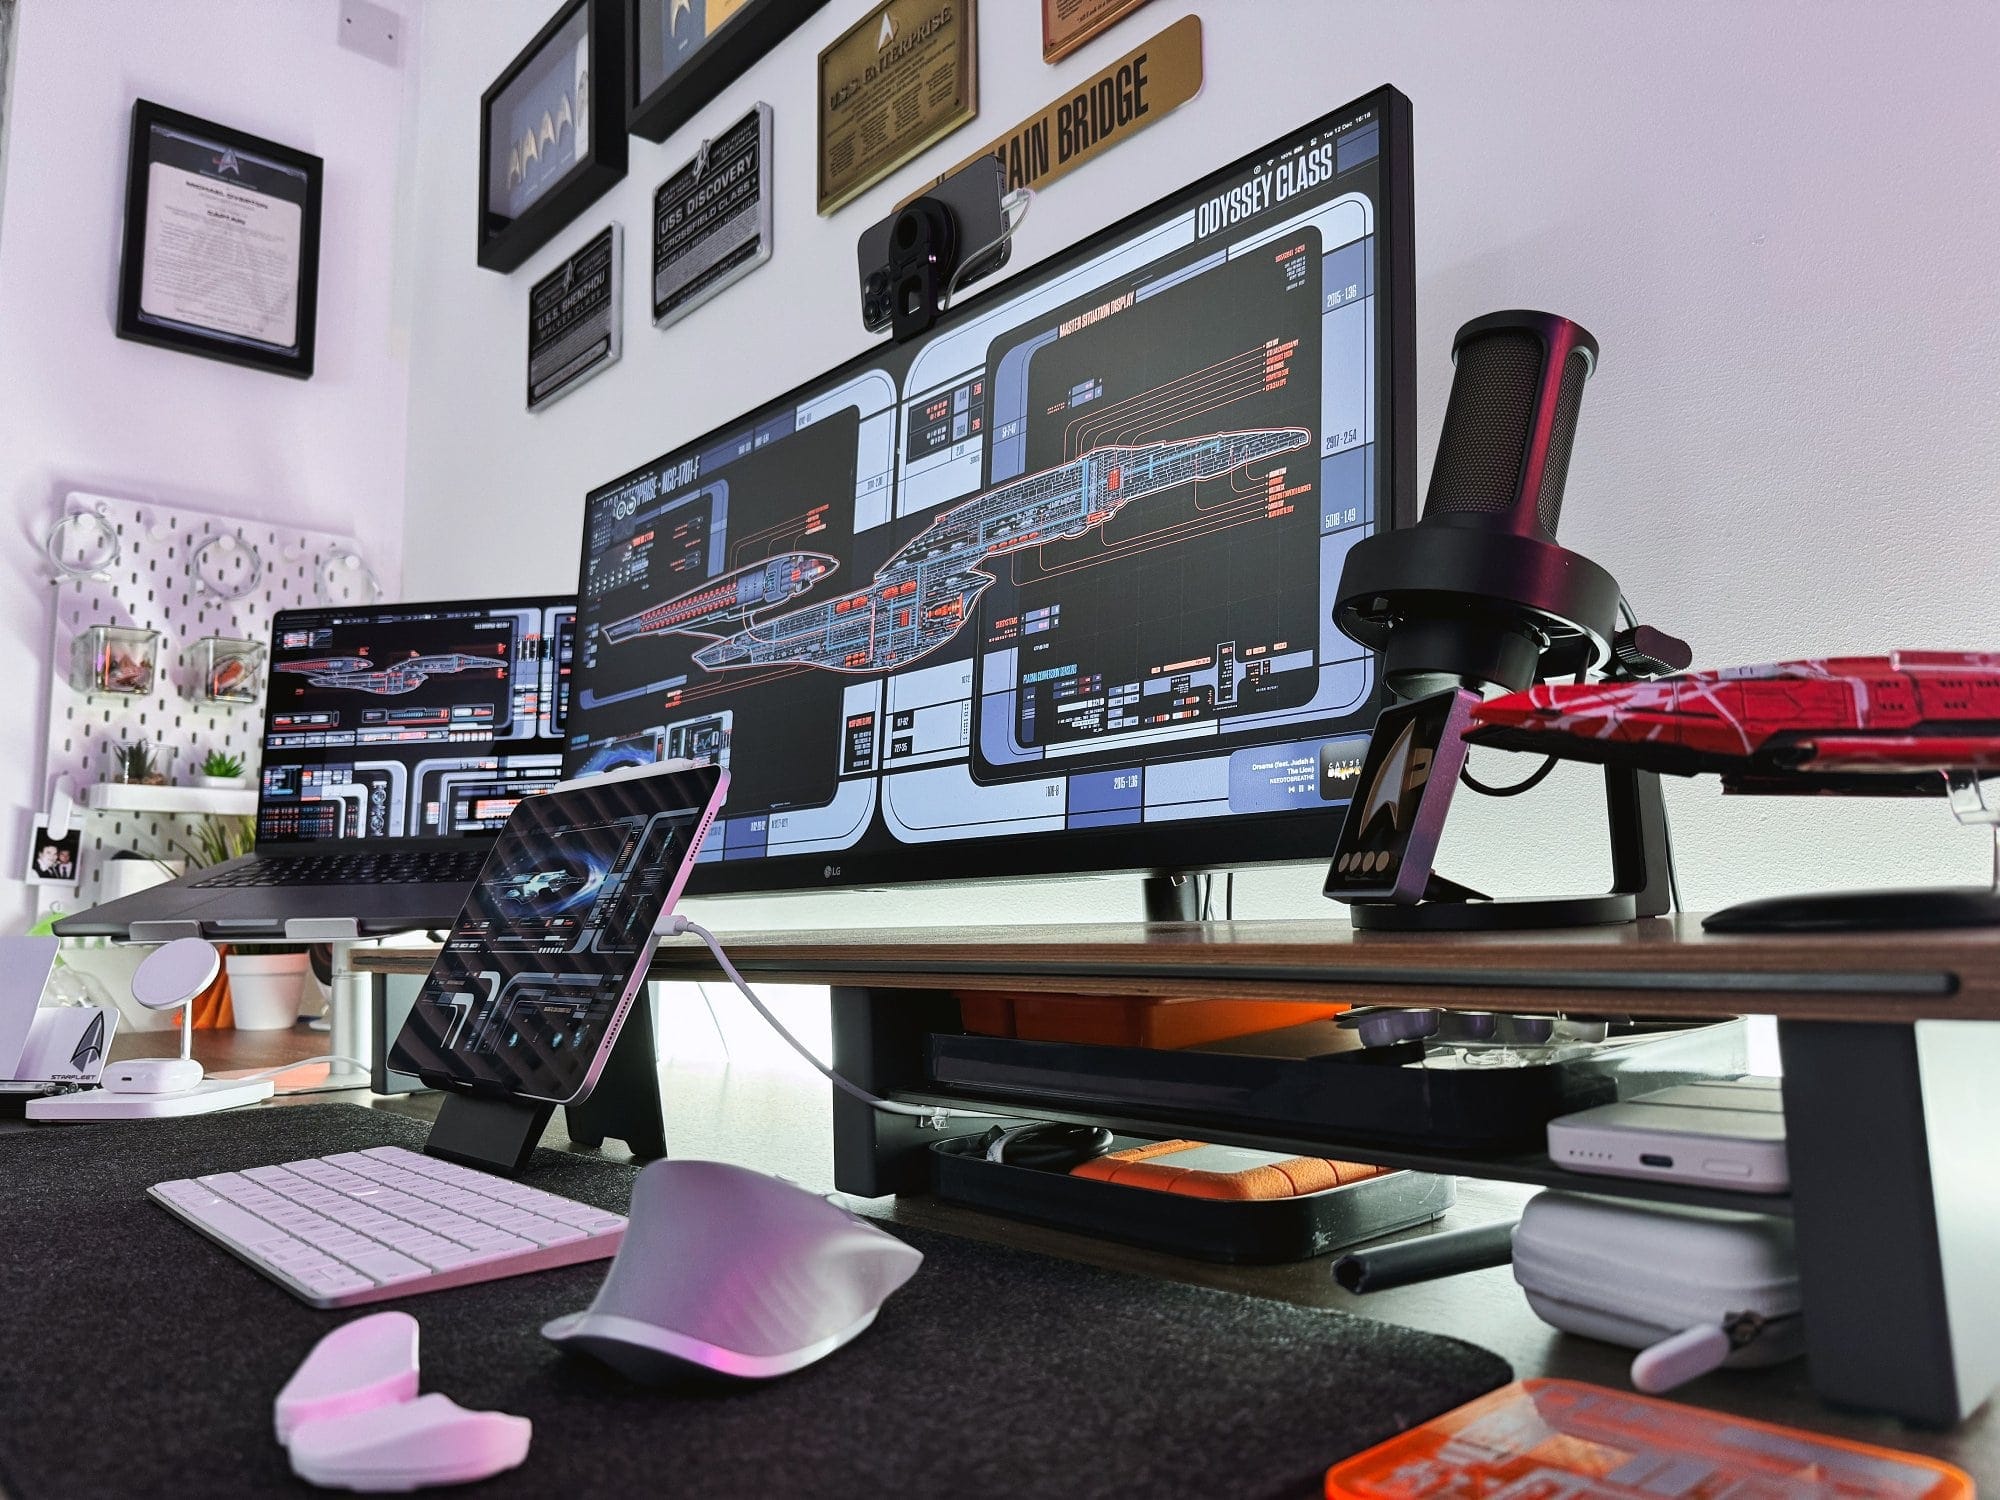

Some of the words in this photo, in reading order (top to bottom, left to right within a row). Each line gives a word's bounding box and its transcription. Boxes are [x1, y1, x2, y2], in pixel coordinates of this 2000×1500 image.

[1057, 52, 1149, 165] BRIDGE
[660, 211, 683, 235] USS
[686, 152, 755, 213] DISCOVERY
[718, 183, 751, 212] CLASS
[1198, 171, 1273, 239] ODYSSEY
[1276, 142, 1332, 202] CLASS
[562, 271, 606, 313] SHENZHOU
[1059, 315, 1082, 339] MASTER
[1081, 302, 1111, 328] SITUATION
[1110, 290, 1135, 316] DISPLAY
